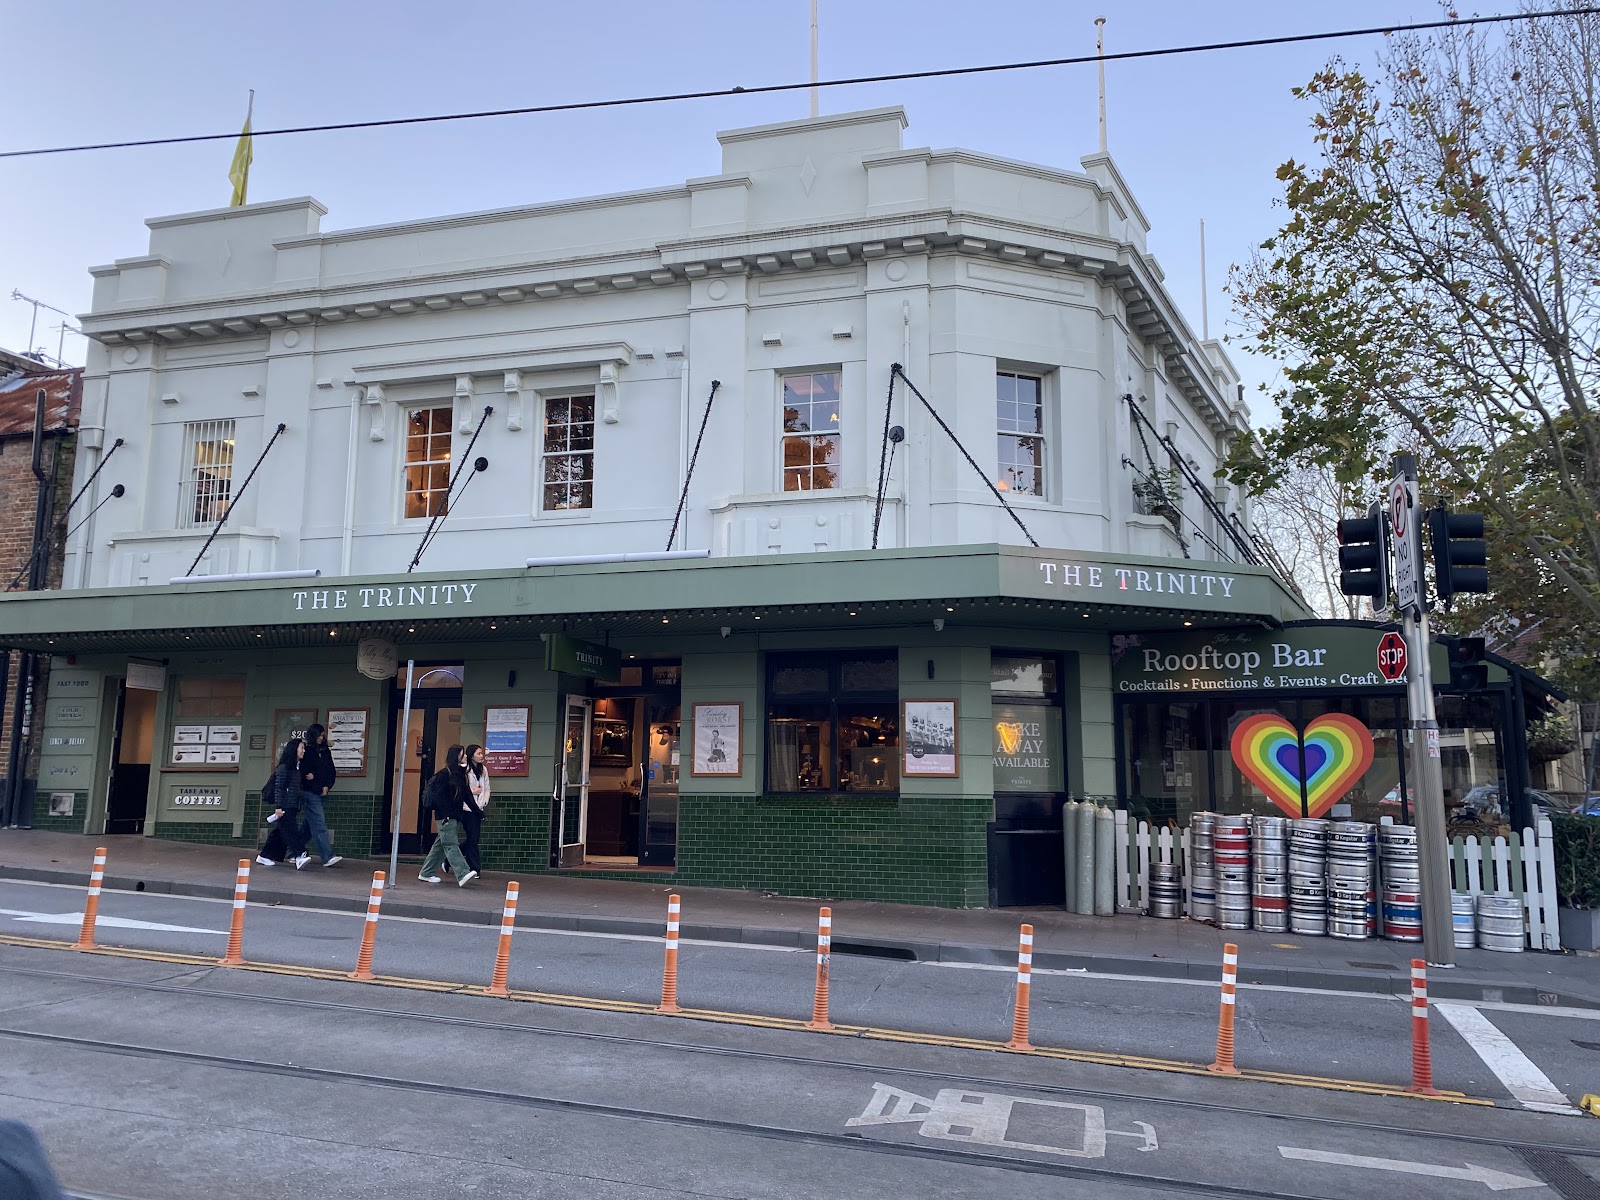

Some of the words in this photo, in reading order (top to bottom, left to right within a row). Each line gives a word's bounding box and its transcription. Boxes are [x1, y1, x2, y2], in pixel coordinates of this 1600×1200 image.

[1398, 541, 1408, 563] NO
[1040, 562, 1103, 587] THE
[1115, 568, 1235, 597] TRINITY
[1398, 564, 1411, 583] RIGHT
[293, 590, 347, 610] THE
[359, 583, 477, 608] TRINITY
[1400, 581, 1413, 600] TURN
[575, 651, 604, 666] TRINITY
[1142, 644, 1260, 676] Rooftop
[1271, 643, 1327, 667] Bar
[1380, 647, 1404, 665] STOP
[1119, 678, 1180, 691] Cocktails
[1191, 677, 1258, 690] Functions
[1263, 676, 1275, 687] &
[1279, 675, 1327, 687] Events
[1339, 671, 1379, 685] Craft
[703, 707, 728, 717] Sunday
[706, 716, 732, 724] ROAST
[992, 757, 1051, 768] AVAILABLE
[174, 795, 222, 805] COFFEE
[1298, 831, 1316, 839] Kegstar
